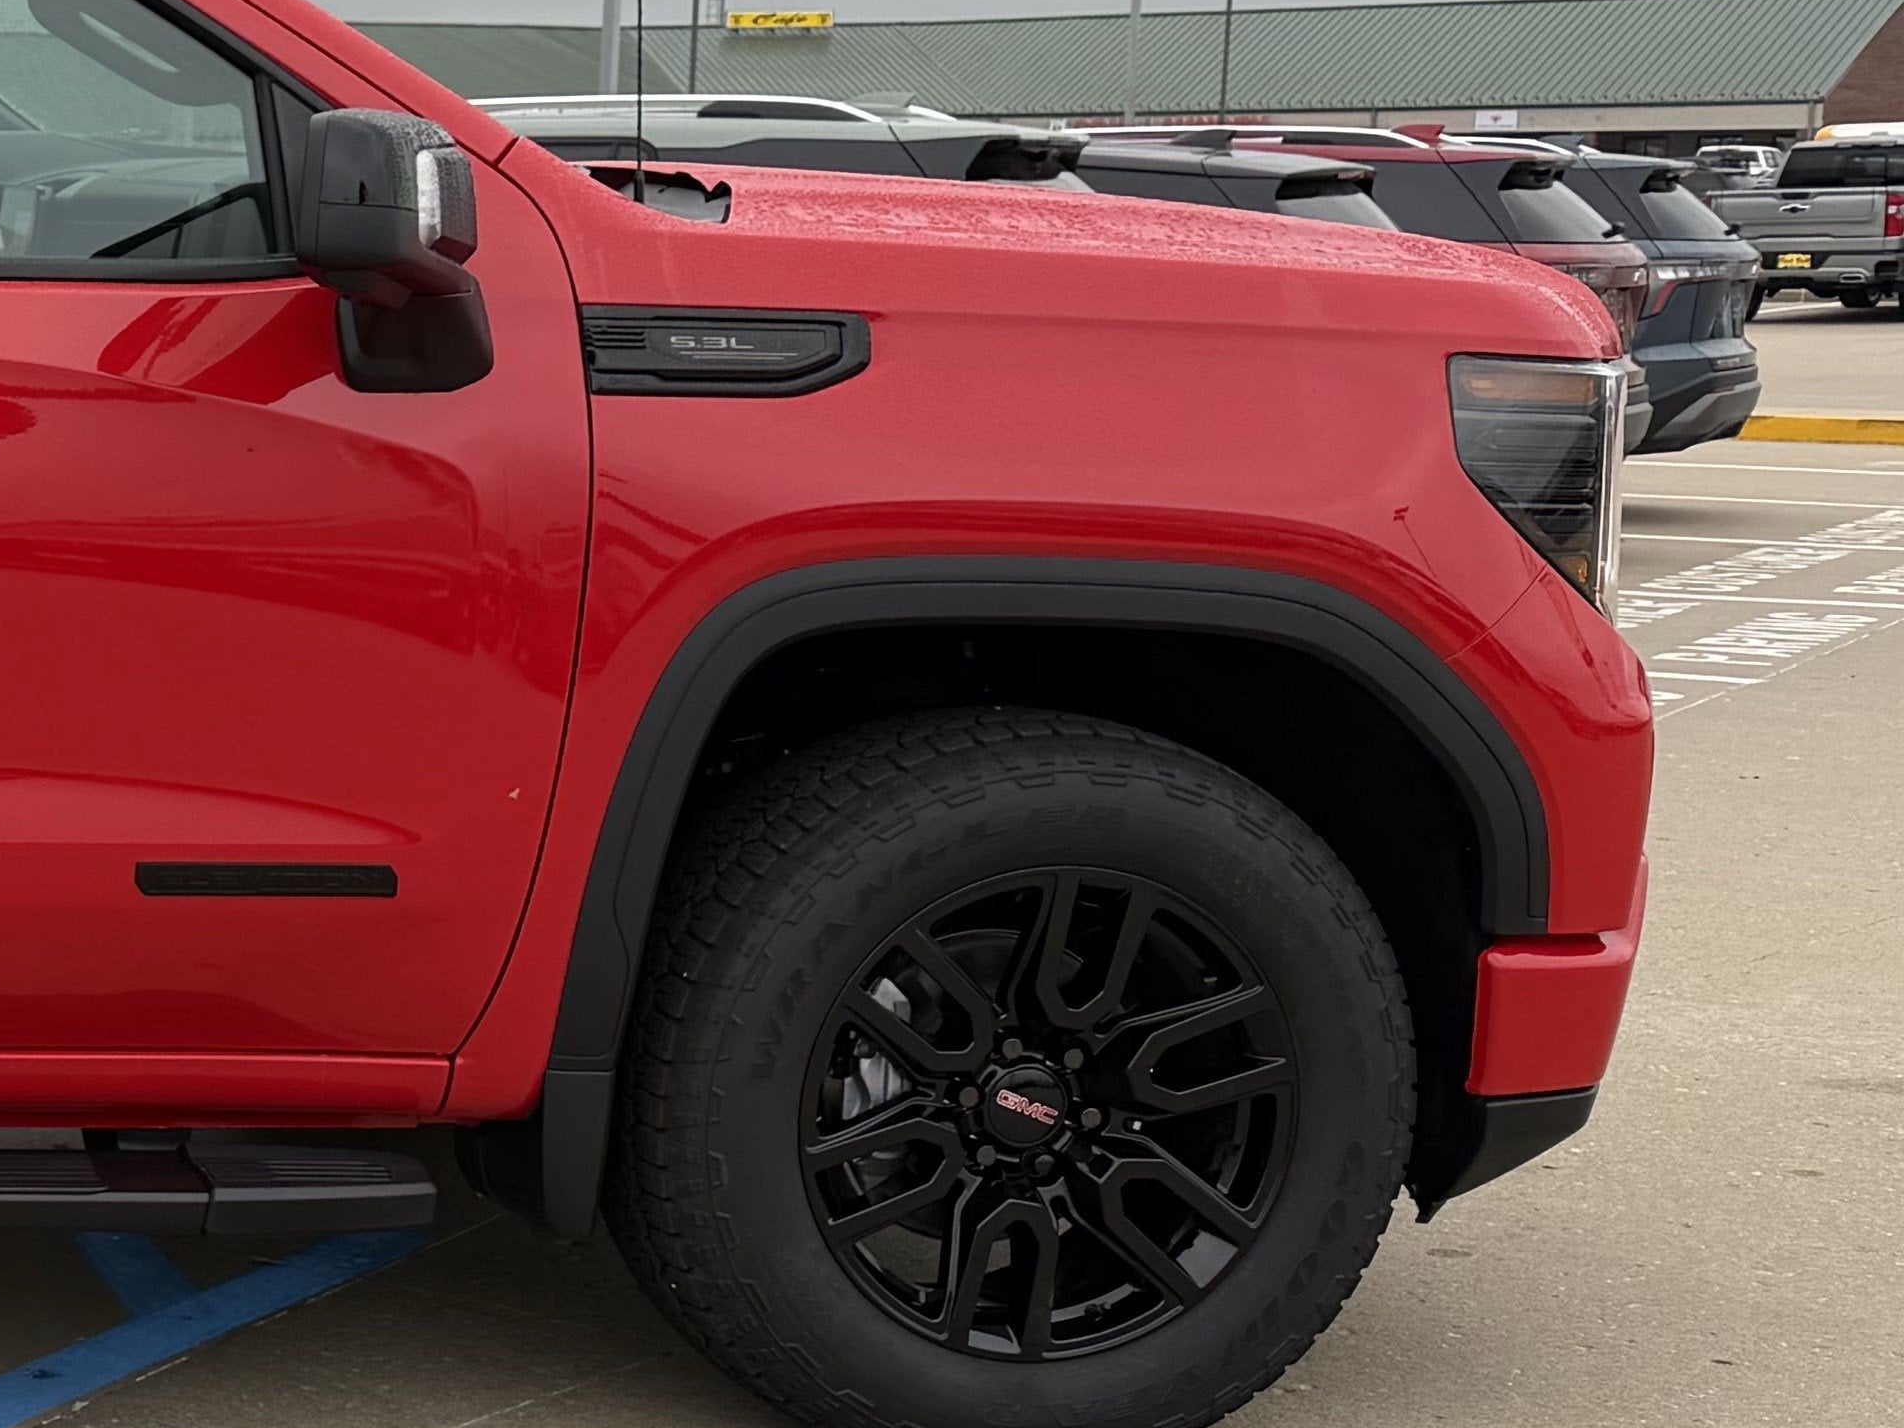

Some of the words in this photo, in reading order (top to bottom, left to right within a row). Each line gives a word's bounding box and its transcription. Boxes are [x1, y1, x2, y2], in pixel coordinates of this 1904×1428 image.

[669, 335, 755, 349] 5.3L
[1652, 612, 1879, 666] PARKING
[996, 1089, 1059, 1125] GMC
